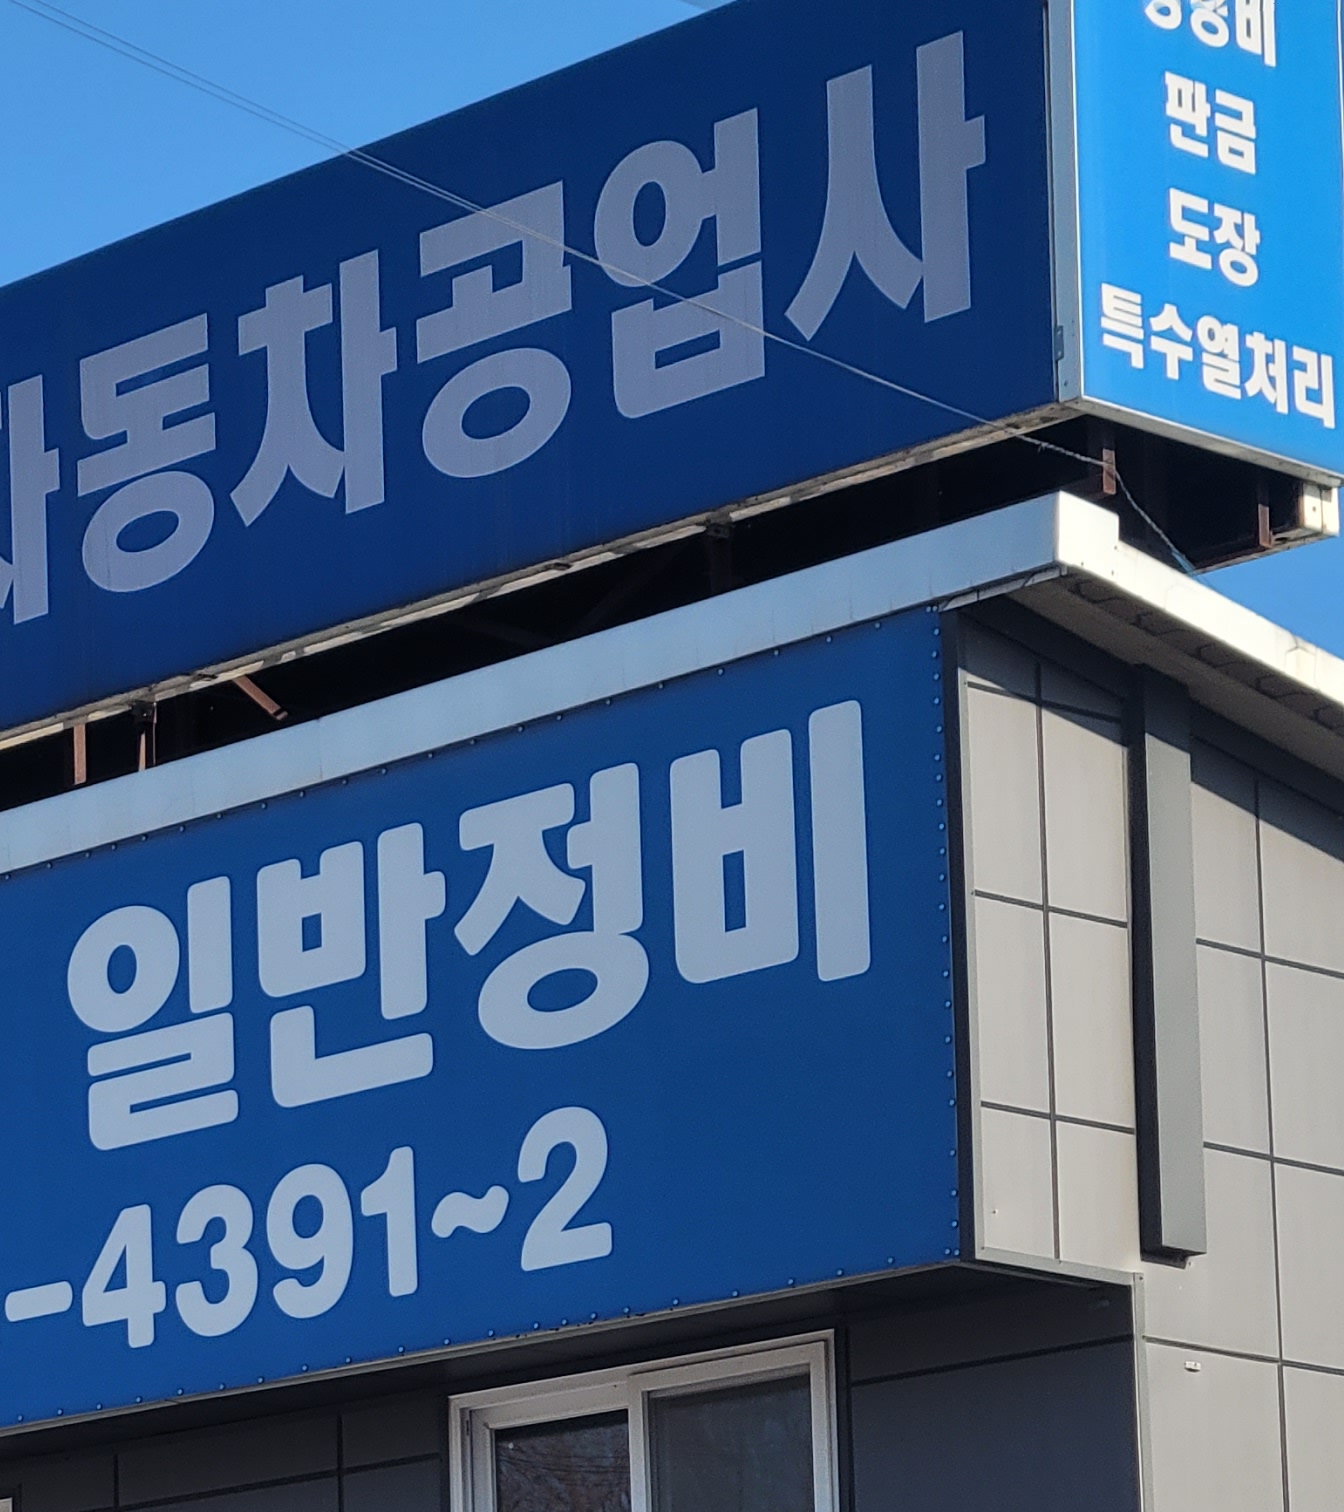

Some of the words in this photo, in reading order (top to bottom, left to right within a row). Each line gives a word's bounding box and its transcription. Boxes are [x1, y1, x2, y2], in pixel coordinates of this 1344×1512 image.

[1165, 72, 1256, 174] 판금
[1169, 188, 1260, 286] 도장
[1100, 282, 1336, 429] 특수열처리
[67, 700, 871, 1151] 일반정비
